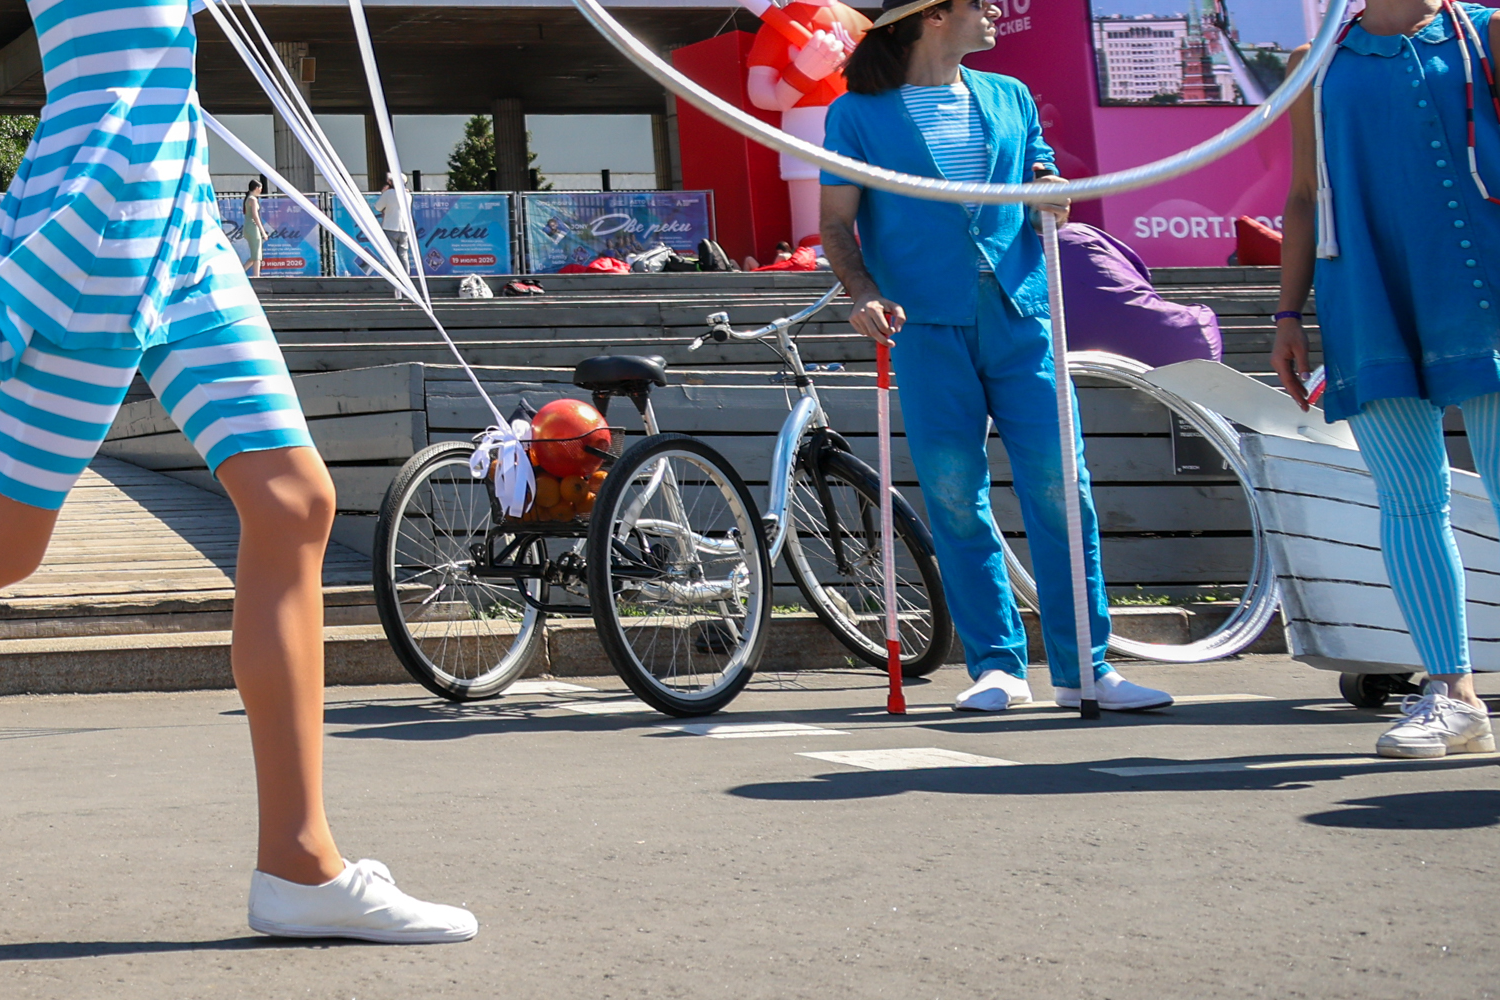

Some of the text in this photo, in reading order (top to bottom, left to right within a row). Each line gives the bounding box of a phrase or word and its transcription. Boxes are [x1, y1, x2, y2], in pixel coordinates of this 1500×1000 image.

[994, 16, 1032, 38] СКВЕ
[425, 223, 489, 248] реки
[590, 213, 692, 239] Две реки
